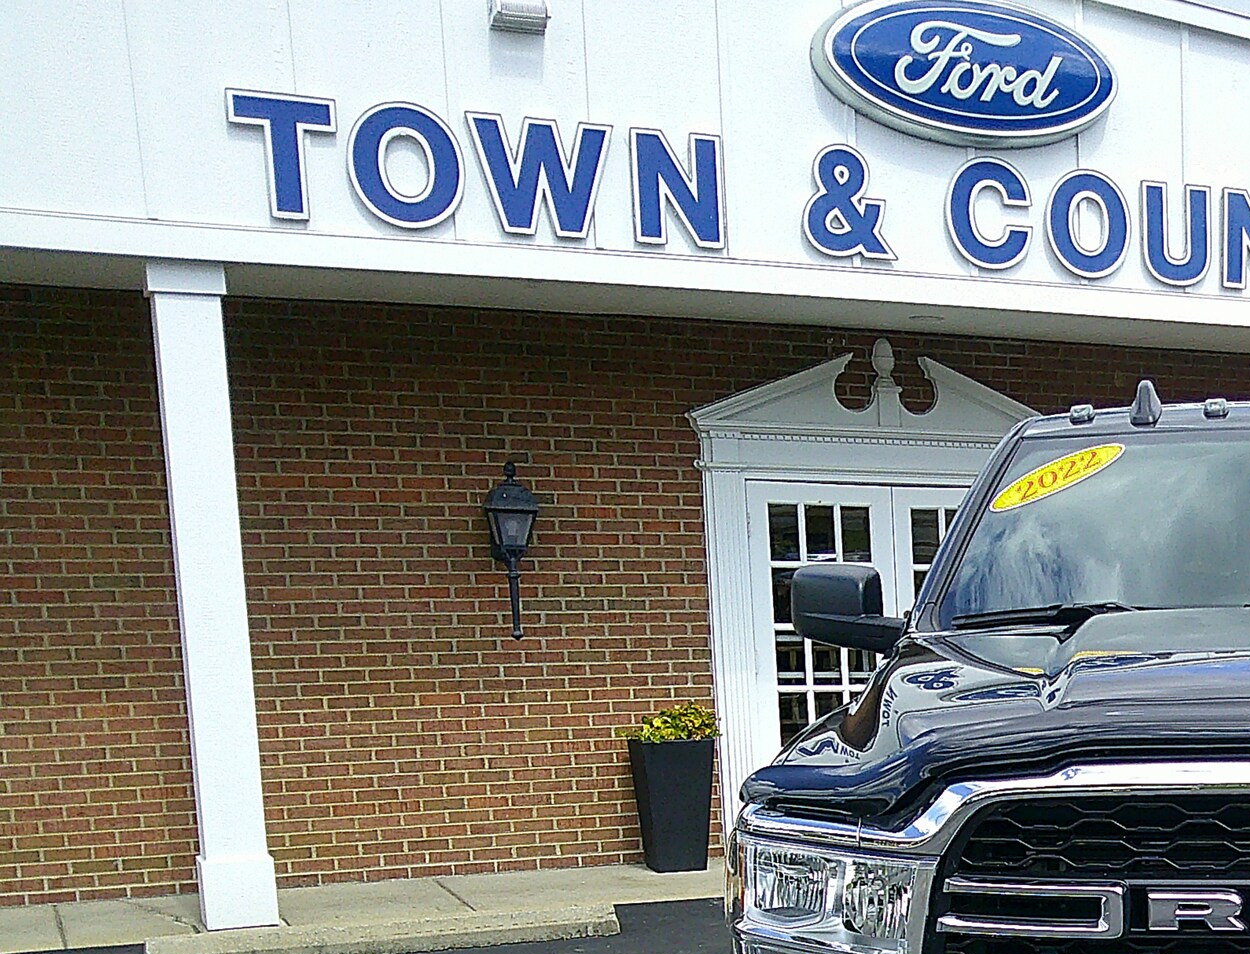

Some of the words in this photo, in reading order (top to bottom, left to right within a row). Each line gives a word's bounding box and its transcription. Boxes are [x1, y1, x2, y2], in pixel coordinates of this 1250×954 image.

[896, 19, 1064, 109] Ford
[225, 87, 727, 250] TOWN
[803, 144, 898, 261] &
[1017, 451, 1101, 500] 2022
